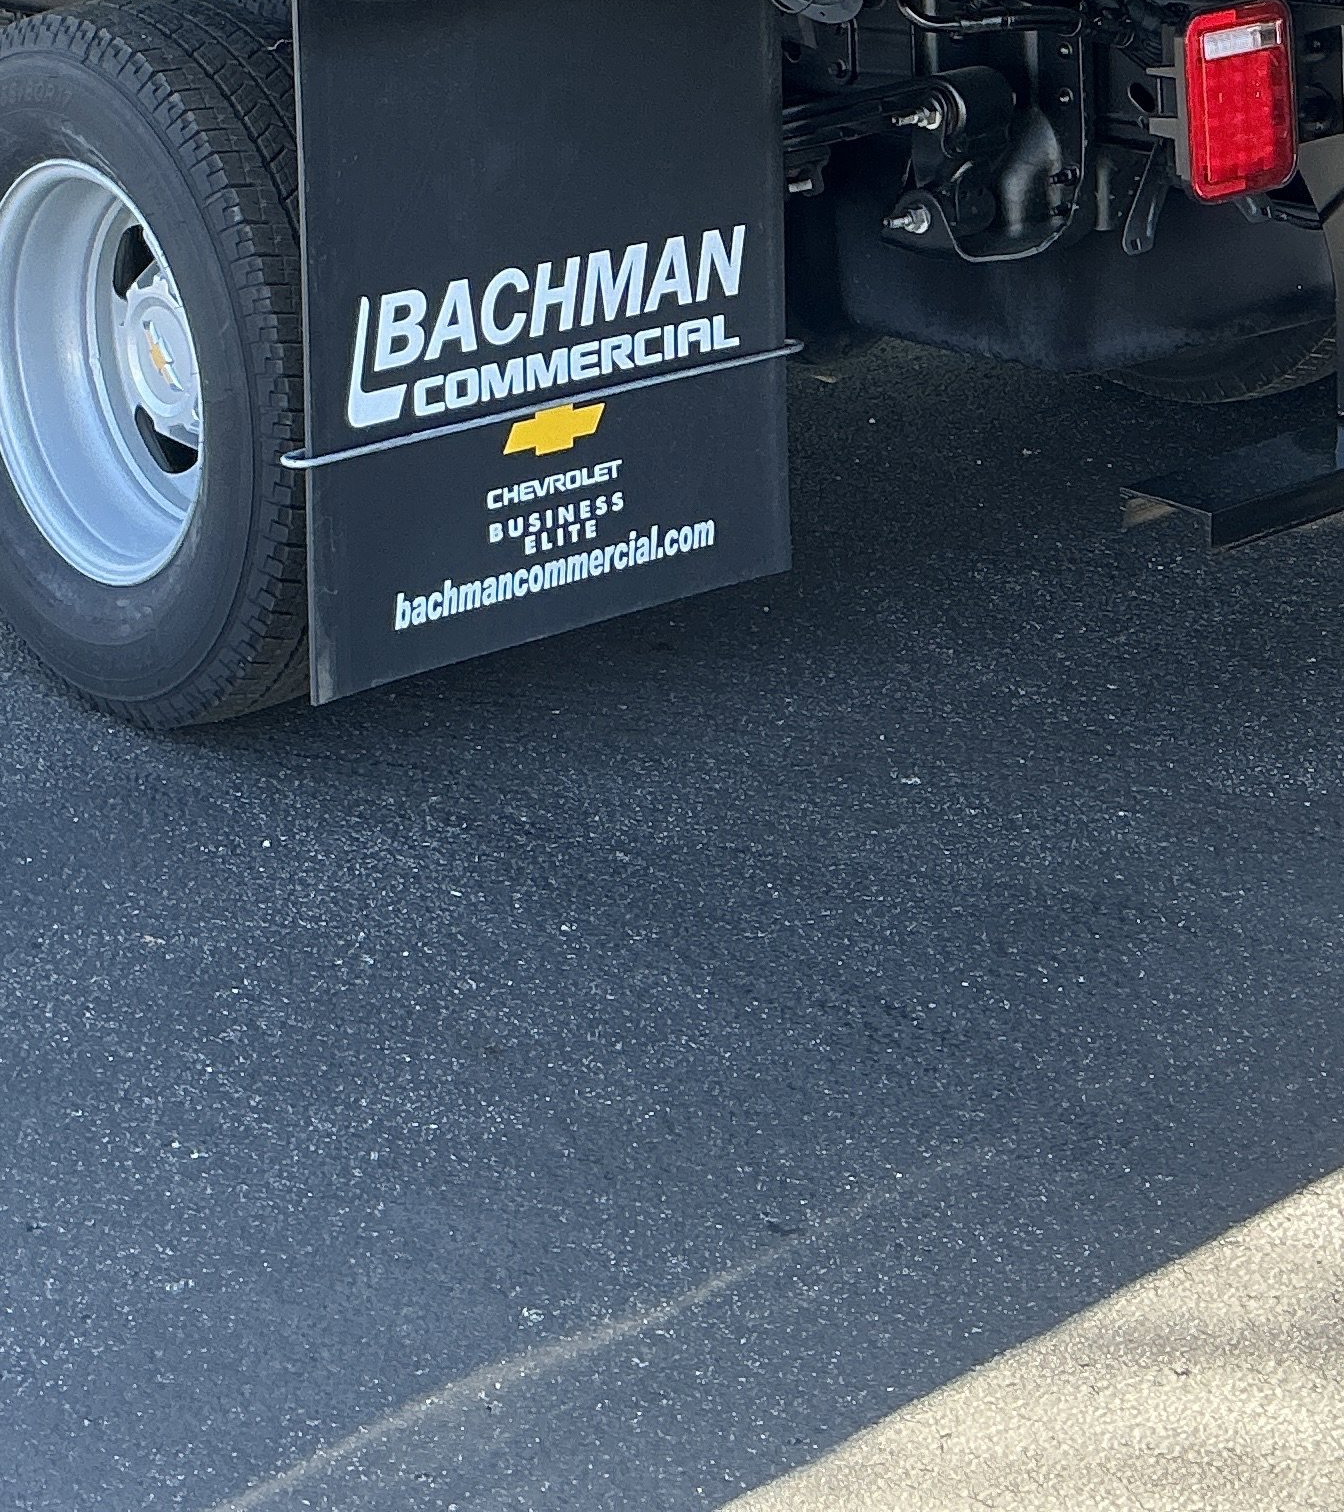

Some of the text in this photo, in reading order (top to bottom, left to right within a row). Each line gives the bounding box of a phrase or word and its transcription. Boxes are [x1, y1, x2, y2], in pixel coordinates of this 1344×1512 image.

[373, 225, 746, 372] BACHMAN
[413, 314, 740, 417] COMMERCIAL
[486, 459, 623, 510] CHEVROLET
[488, 491, 625, 543] BUSINESS
[394, 518, 716, 631] bachmancommercial.com
[524, 518, 598, 556] ELITE
